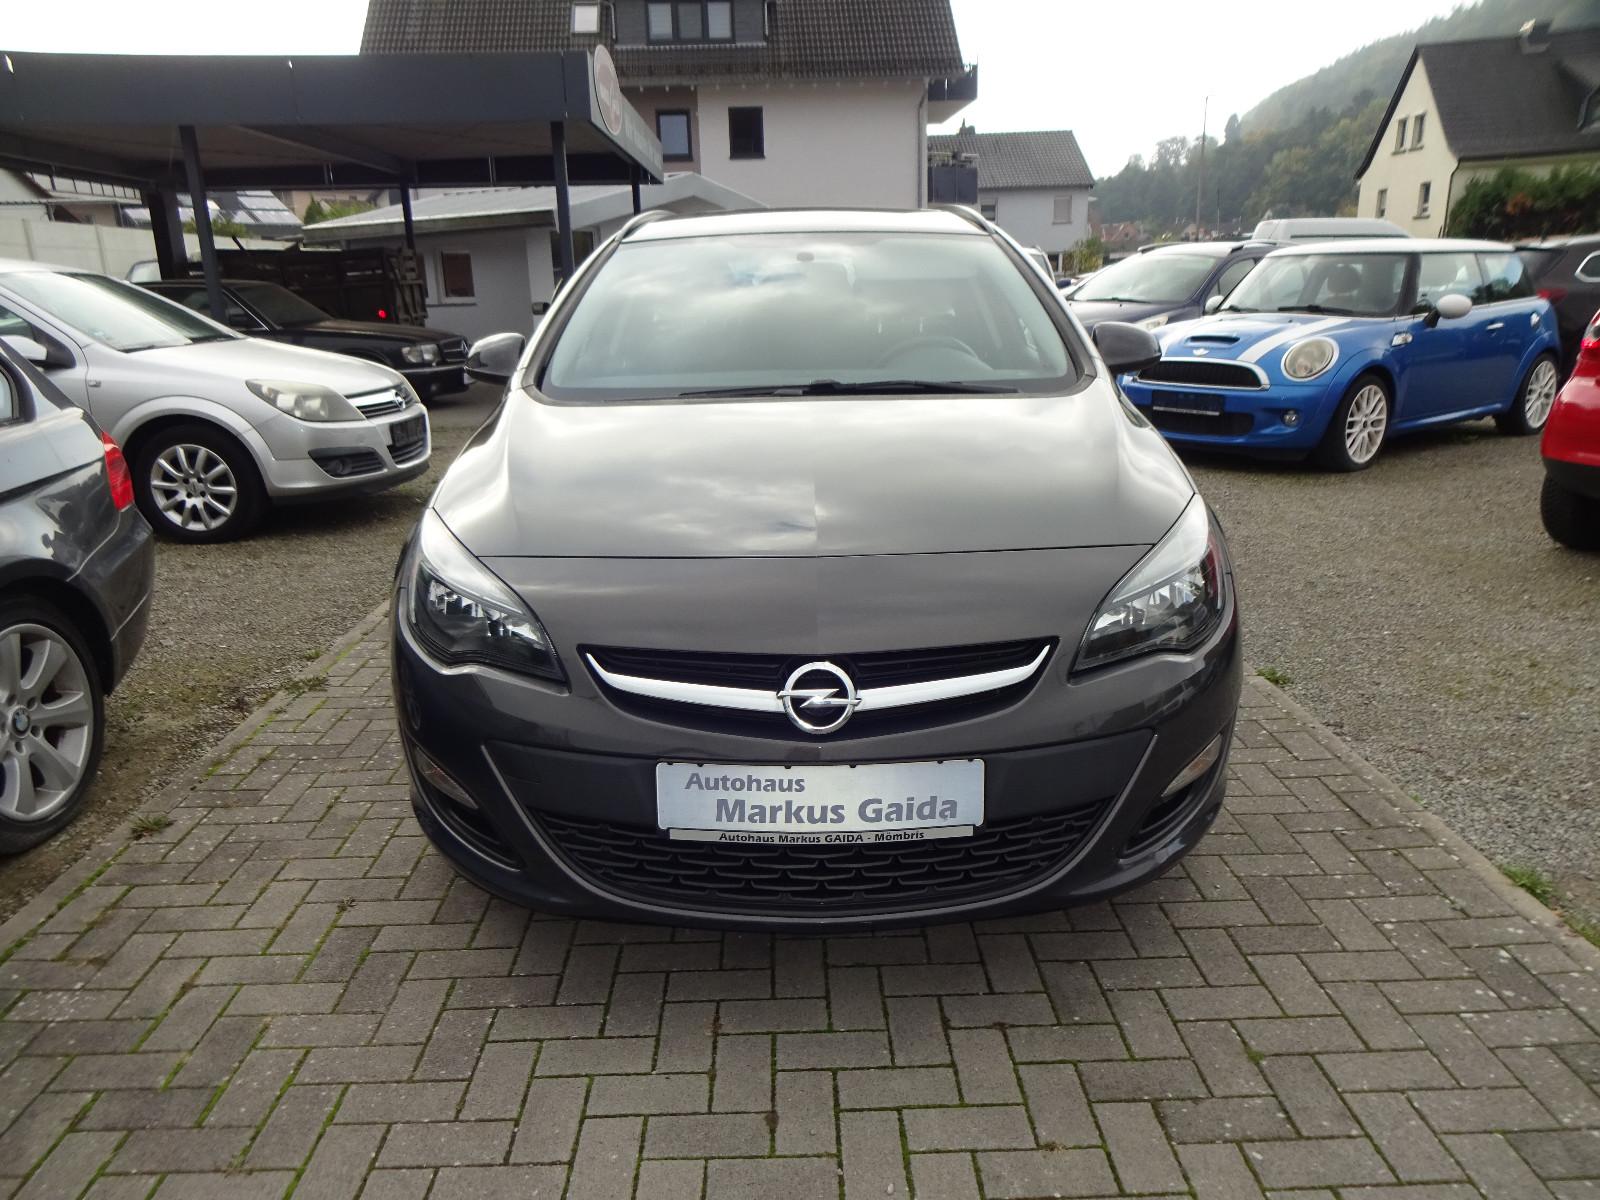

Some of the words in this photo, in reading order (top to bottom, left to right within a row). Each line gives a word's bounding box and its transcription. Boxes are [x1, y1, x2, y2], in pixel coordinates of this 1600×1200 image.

[685, 772, 805, 793] Autohaus
[715, 798, 845, 824] Markus
[857, 796, 958, 823] Gaida
[719, 832, 775, 844] Autohaus
[778, 834, 821, 844] Markus
[824, 834, 863, 844] GAIDA
[874, 831, 925, 842] Mömbris
